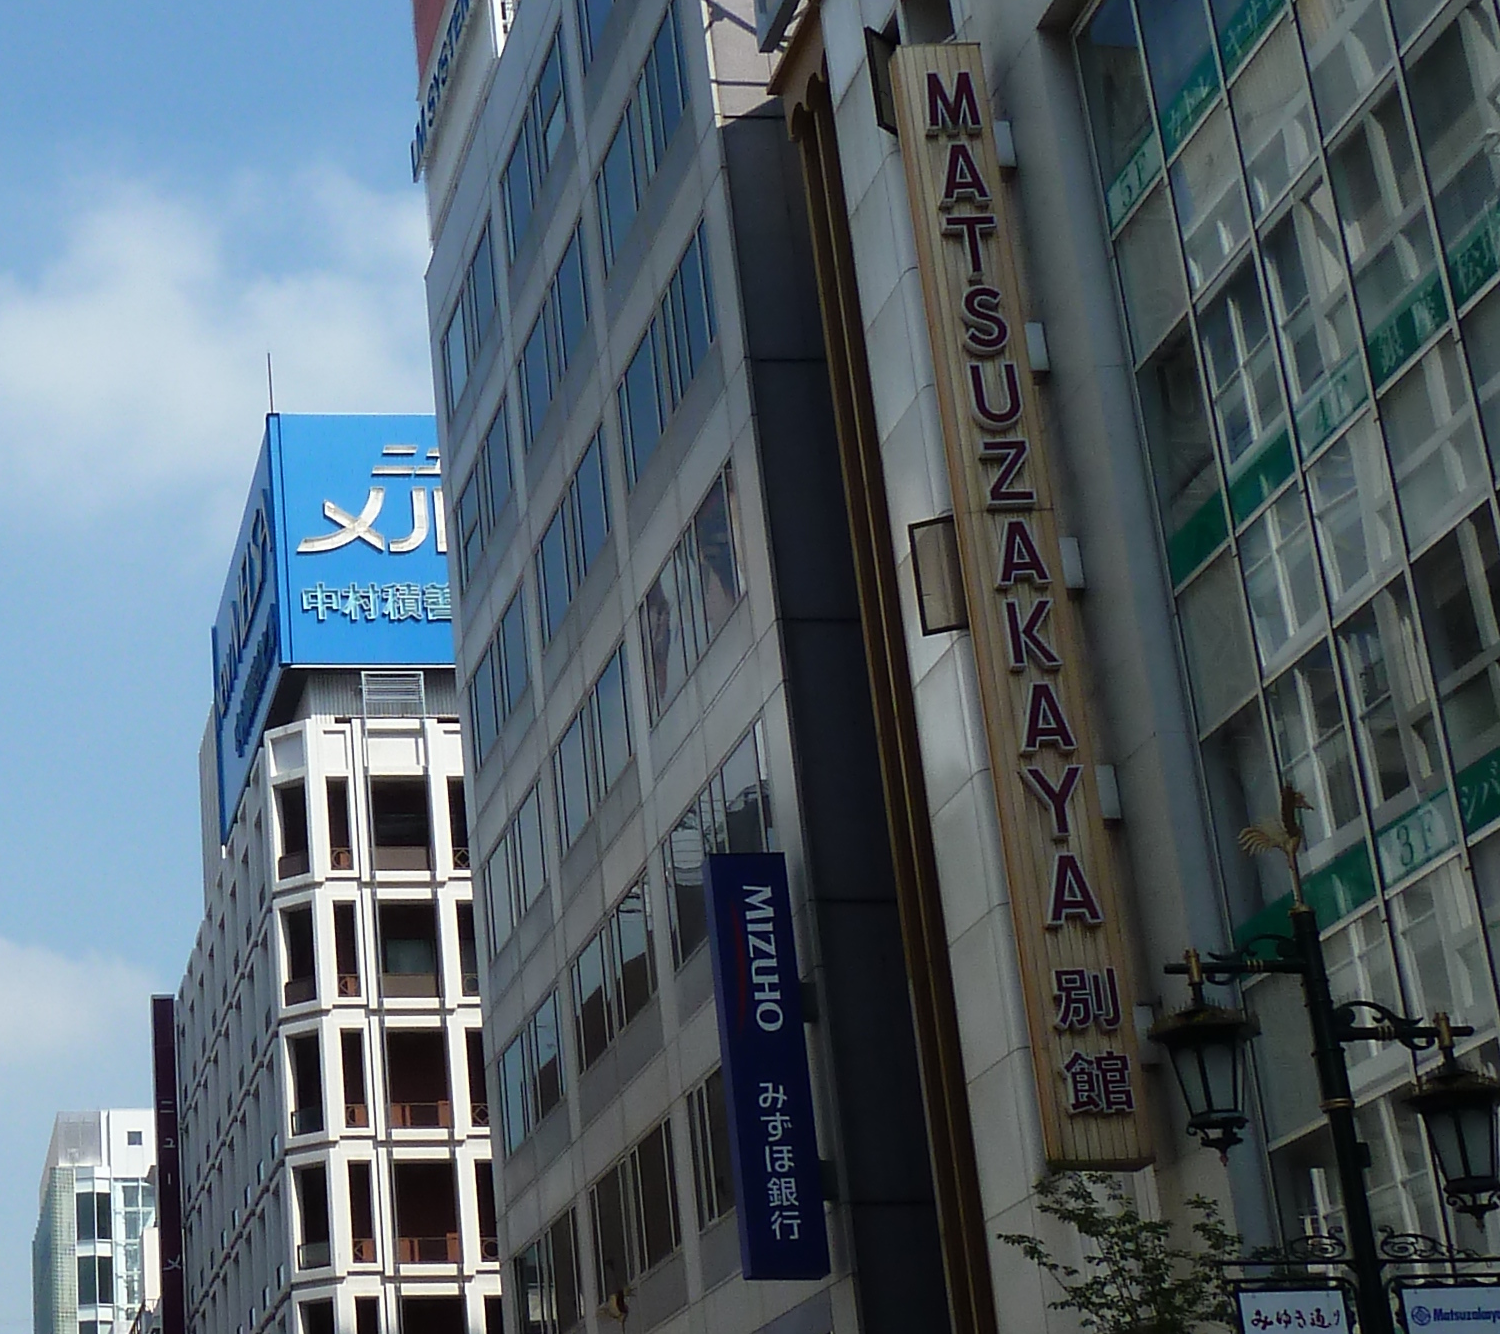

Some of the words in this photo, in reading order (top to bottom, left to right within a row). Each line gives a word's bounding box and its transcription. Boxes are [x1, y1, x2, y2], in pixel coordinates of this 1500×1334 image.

[925, 71, 1103, 929] MATSUZAKAYA
[1051, 966, 1136, 1115] 別館
[742, 885, 785, 1034] MIZUHO
[757, 1082, 802, 1242] みずほ銀行
[1251, 1307, 1341, 1331] みゆき通り
